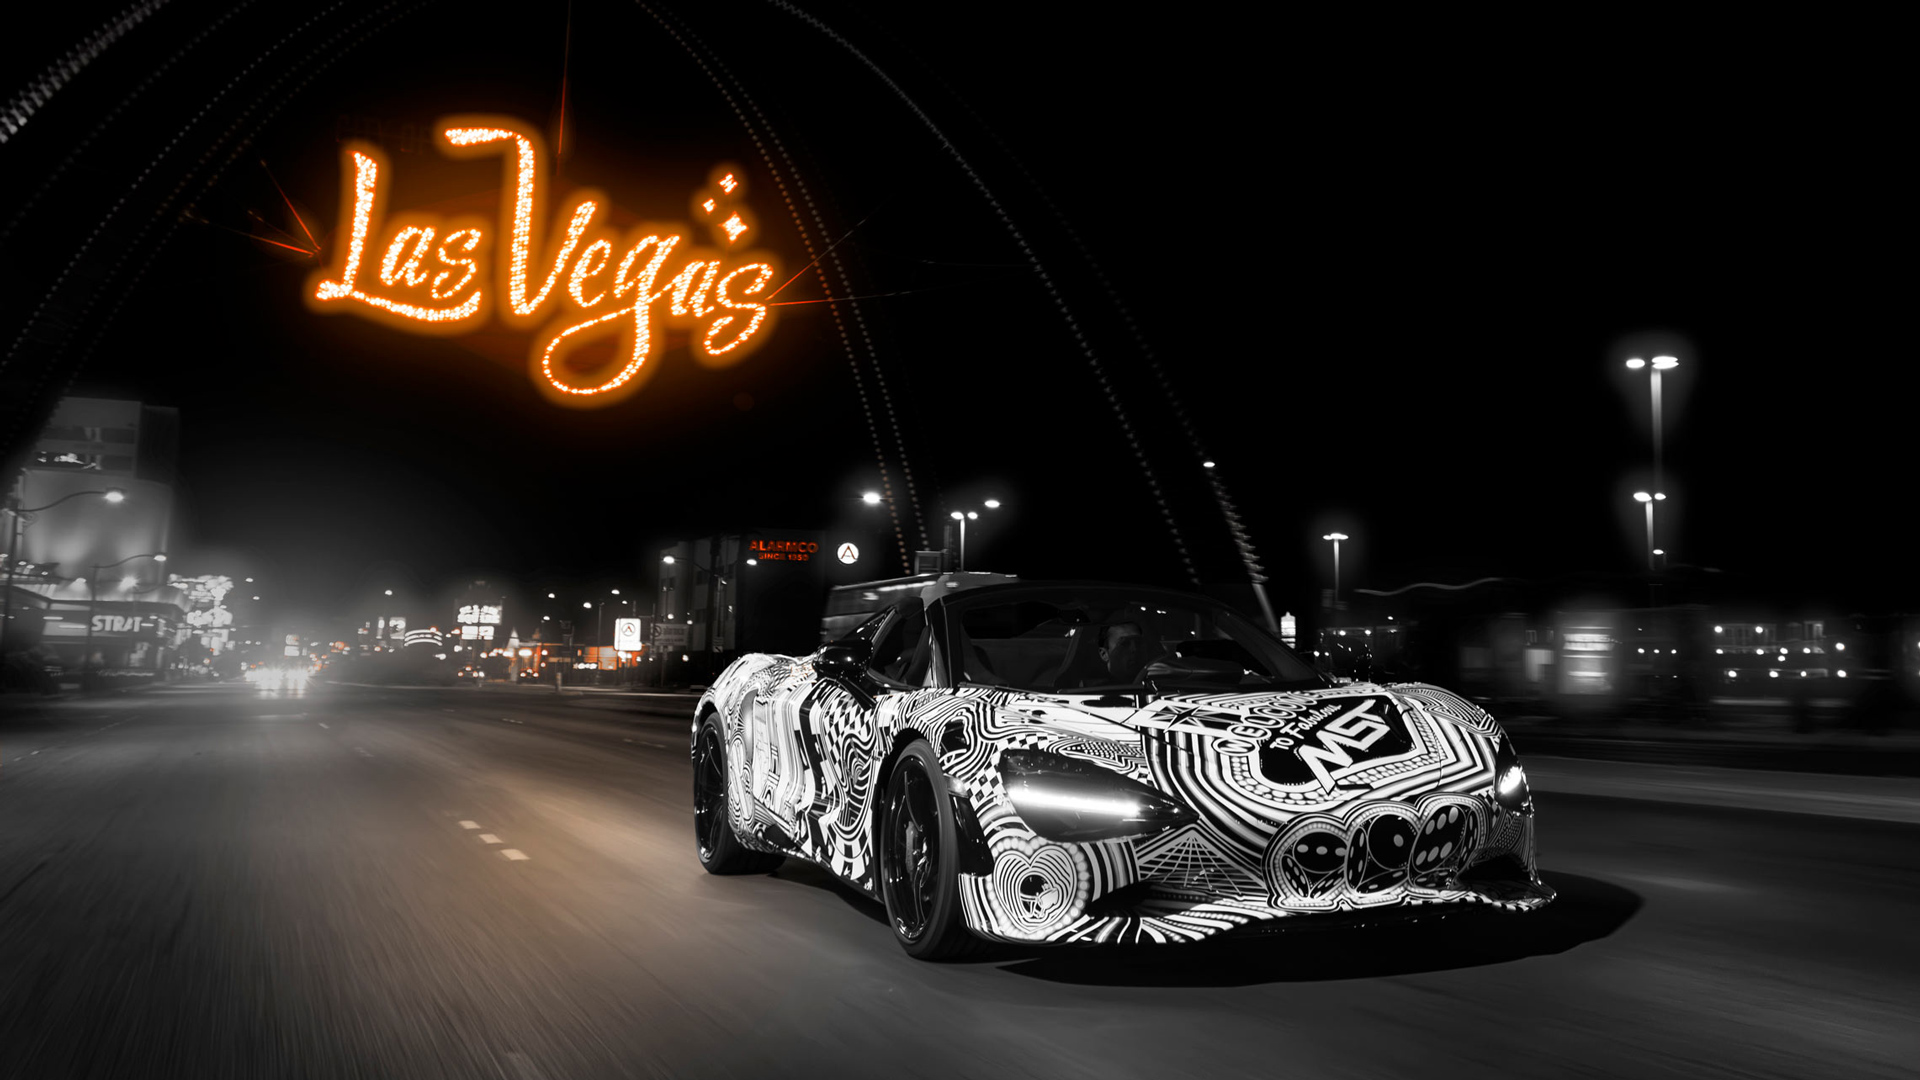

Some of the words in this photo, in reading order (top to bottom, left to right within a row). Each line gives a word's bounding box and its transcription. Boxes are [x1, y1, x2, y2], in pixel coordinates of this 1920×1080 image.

[315, 151, 482, 322] Las
[445, 128, 774, 395] Vegas
[748, 539, 819, 553] ALARMCO
[91, 614, 144, 633] STRAT
